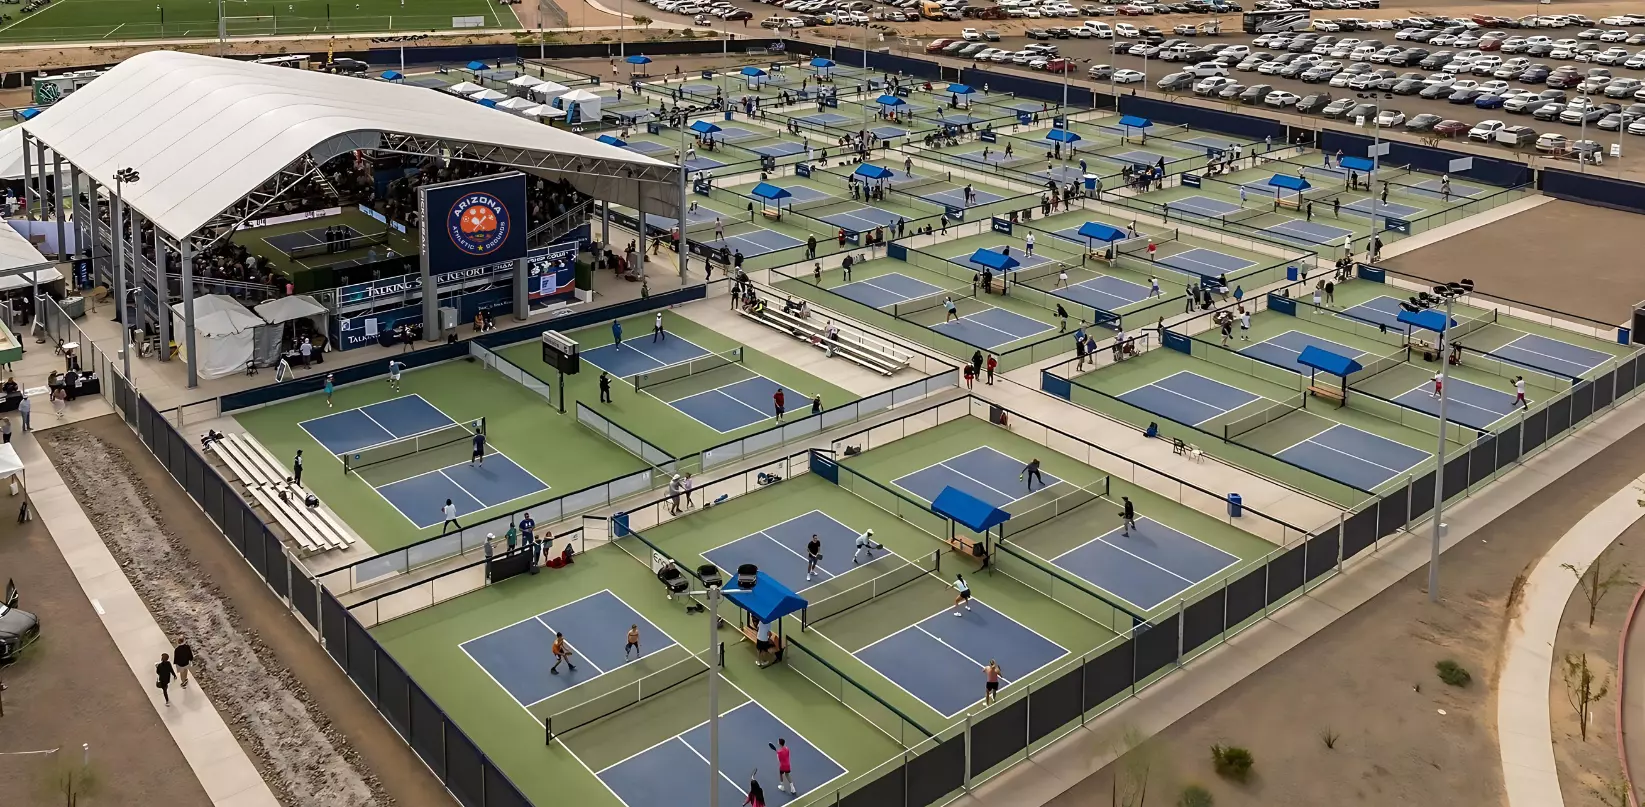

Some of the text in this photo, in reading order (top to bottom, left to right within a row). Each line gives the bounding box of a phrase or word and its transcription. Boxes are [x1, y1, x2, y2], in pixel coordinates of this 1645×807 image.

[454, 196, 501, 218] ARIZONA
[452, 225, 475, 250] ATHLETIC
[366, 282, 412, 297] TALKING
